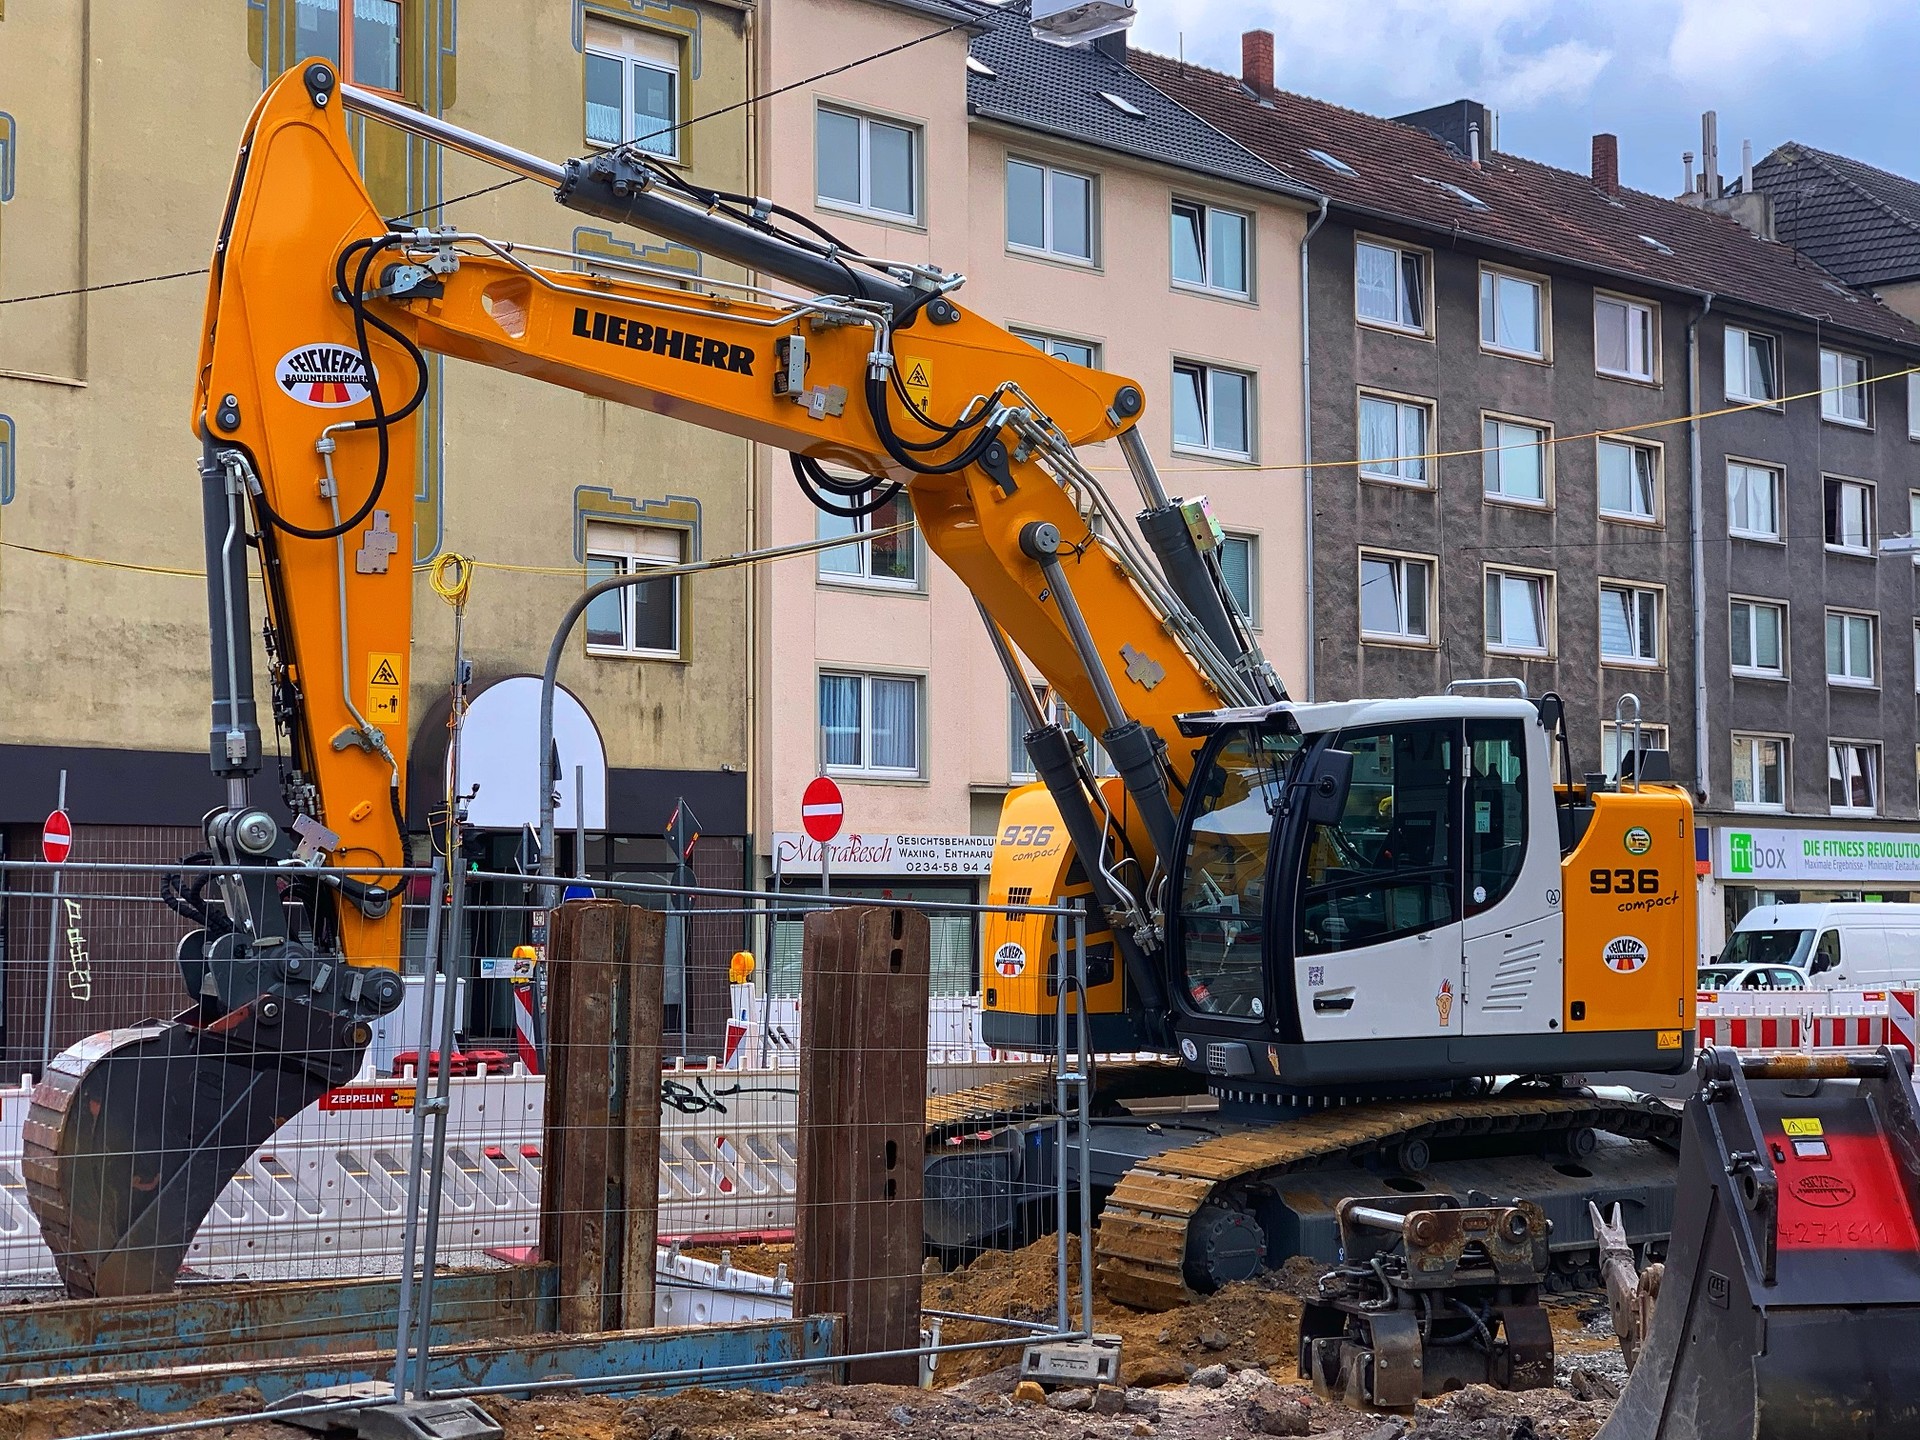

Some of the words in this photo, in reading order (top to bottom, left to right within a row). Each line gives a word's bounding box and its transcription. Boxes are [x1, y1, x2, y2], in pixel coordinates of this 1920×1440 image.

[572, 307, 755, 376] LIEBHERR
[288, 349, 365, 373] FEICKERT
[896, 836, 996, 846] GESICHTSBEHANDLU
[1001, 826, 1055, 846] 936
[779, 834, 892, 862] Marrakesch
[899, 848, 939, 859] WAXING,
[1012, 843, 1061, 862] compact
[1803, 839, 1820, 857] DIE
[1823, 840, 1865, 858] FITNESS
[906, 862, 958, 872] 0234-58
[963, 862, 978, 872] 94
[1590, 869, 1659, 894] 936
[1617, 890, 1679, 912] compact
[331, 1093, 384, 1104] ZEPPELIN
